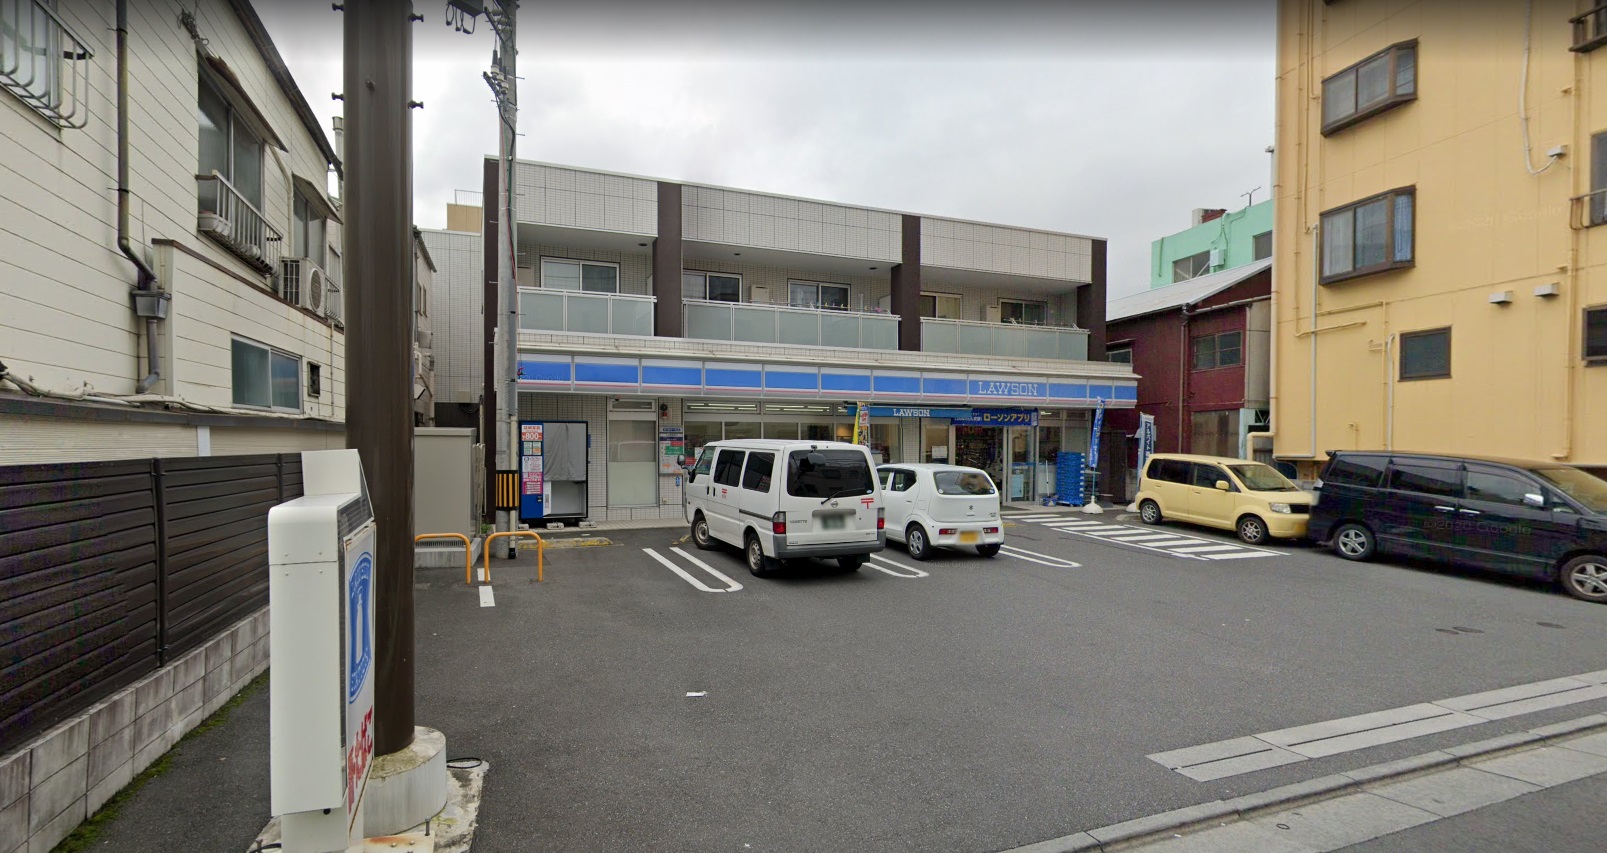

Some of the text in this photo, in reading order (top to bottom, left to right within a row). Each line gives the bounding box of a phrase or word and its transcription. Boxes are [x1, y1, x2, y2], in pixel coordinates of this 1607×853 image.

[977, 381, 1038, 396] LAWSON
[892, 408, 931, 417] LAWSON
[983, 413, 1030, 422] ローソンアプリ
